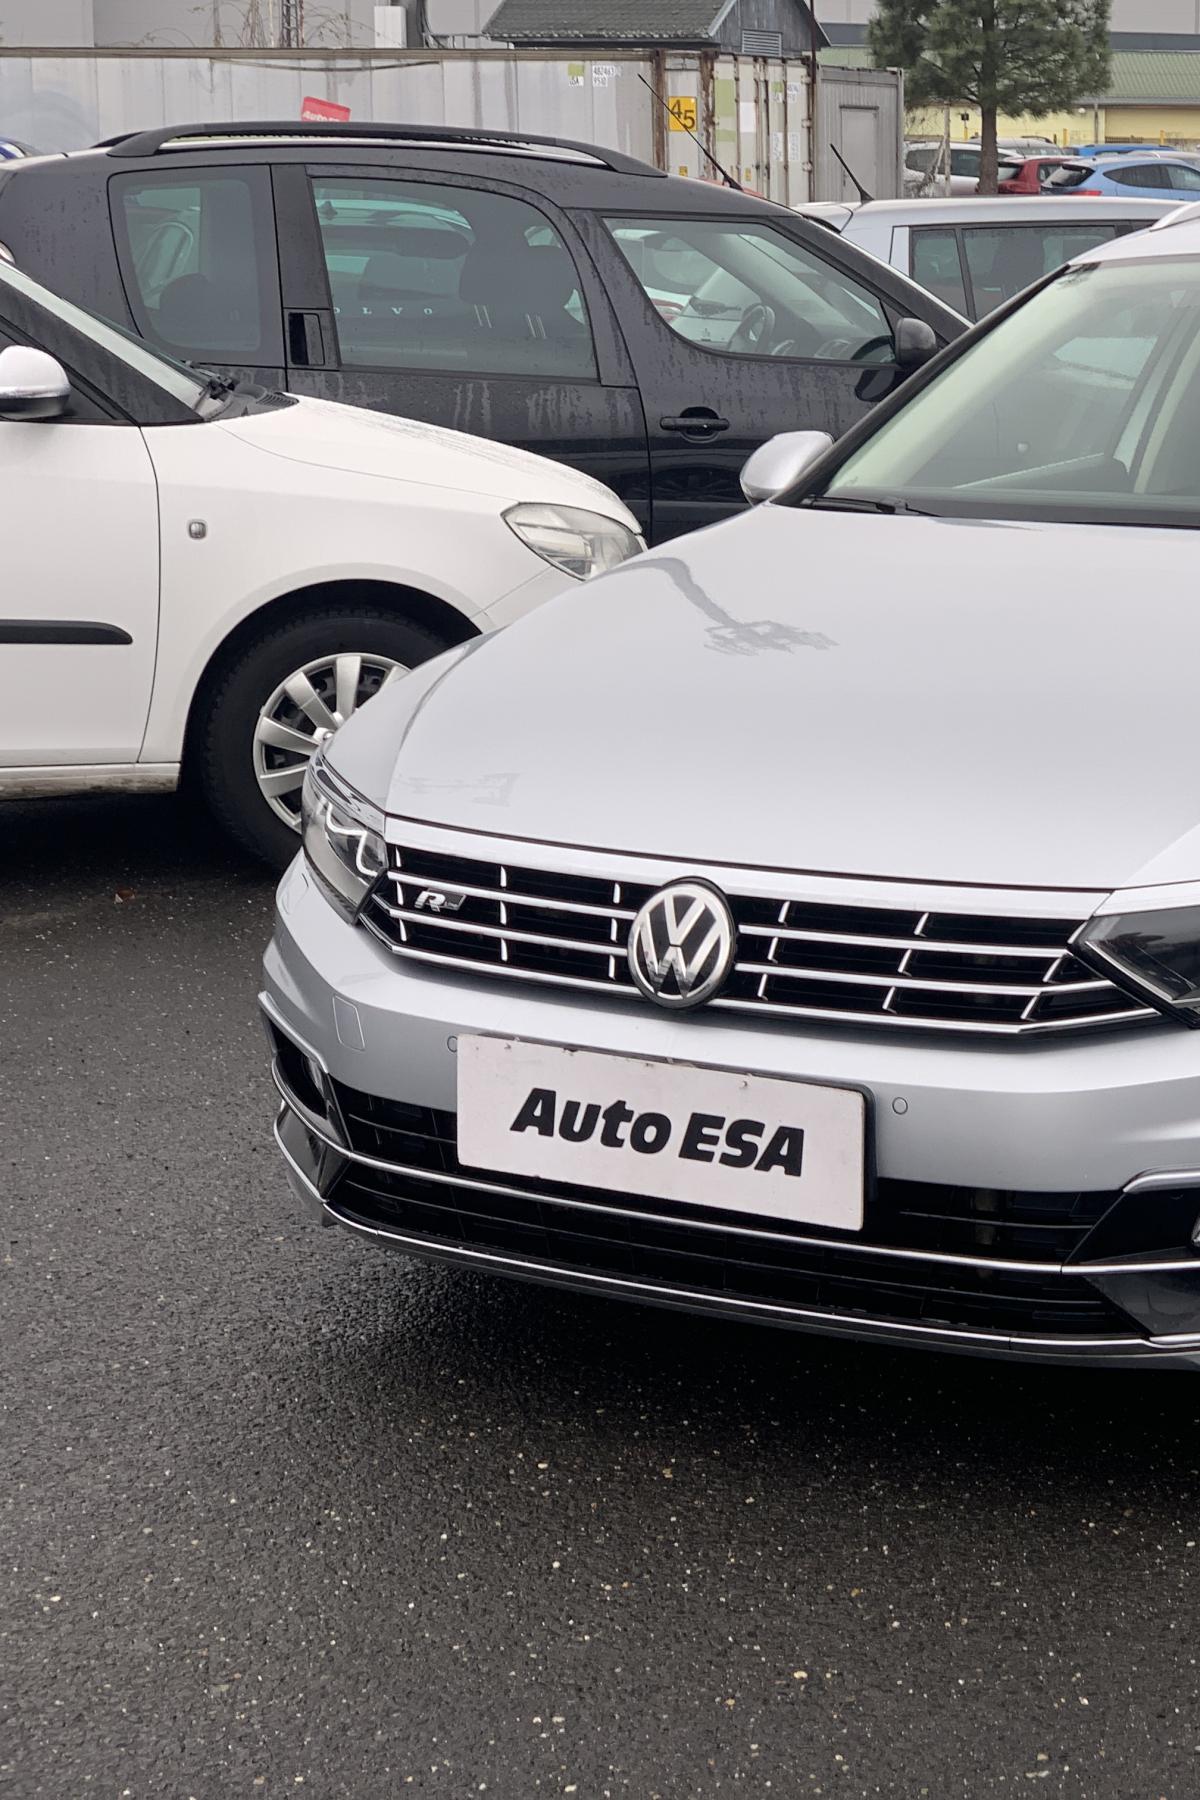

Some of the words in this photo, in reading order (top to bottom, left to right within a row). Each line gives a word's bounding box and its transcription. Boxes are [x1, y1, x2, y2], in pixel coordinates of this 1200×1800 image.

[333, 306, 433, 315] OLVO
[510, 1087, 672, 1154] Auto
[678, 1112, 805, 1177] ESA
